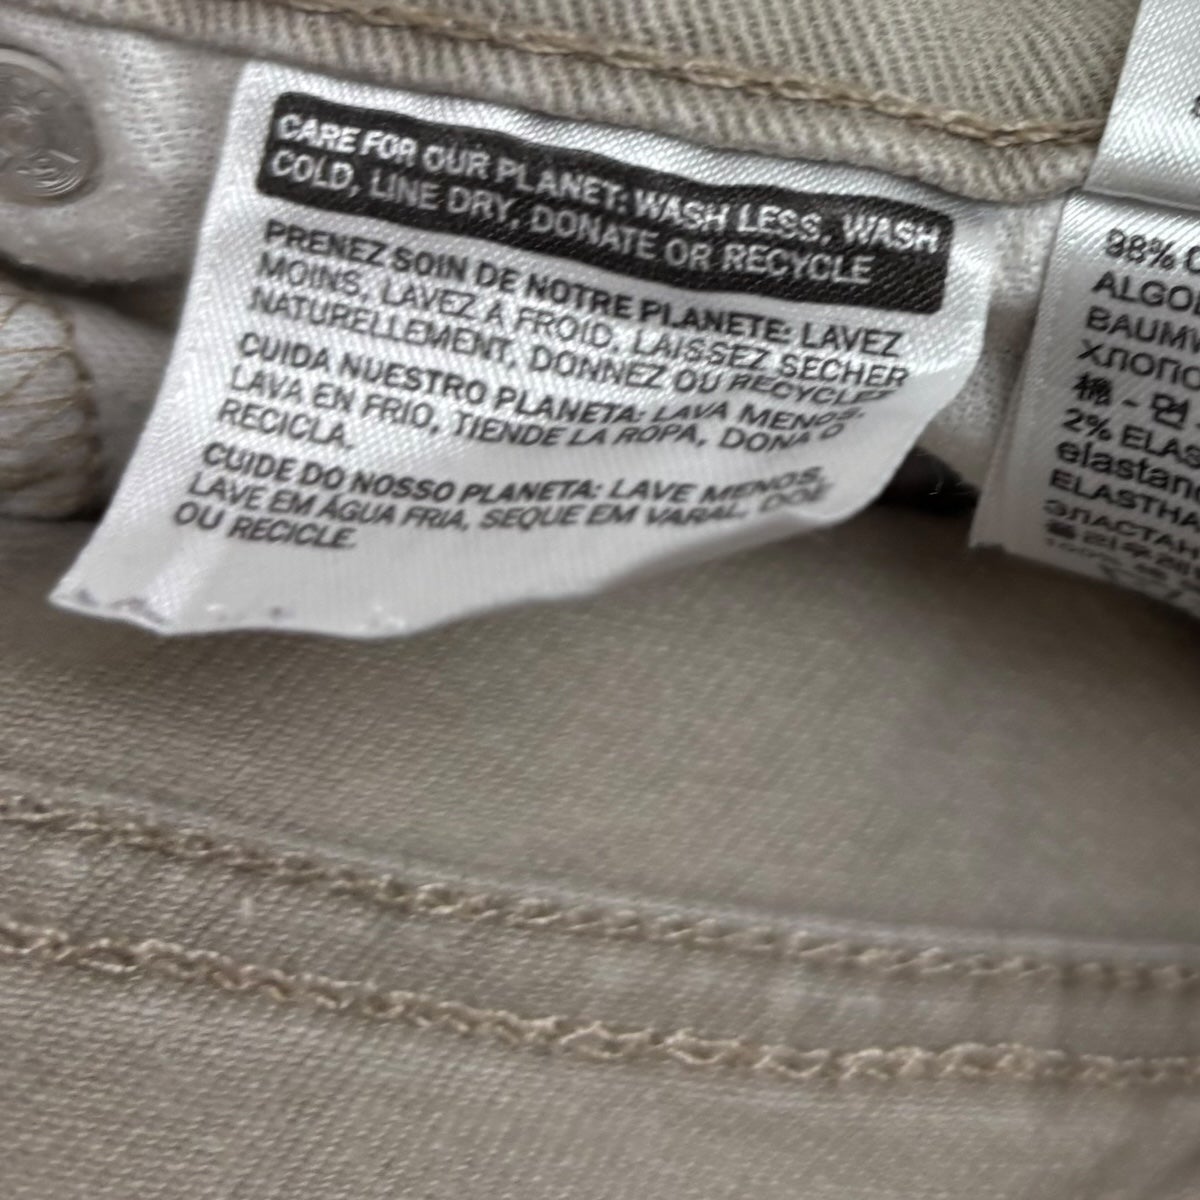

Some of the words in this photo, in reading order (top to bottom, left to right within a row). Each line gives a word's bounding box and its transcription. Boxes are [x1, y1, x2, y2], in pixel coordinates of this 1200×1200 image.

[270, 150, 362, 198] COLD,
[370, 168, 441, 211] LINE
[530, 205, 660, 260] DONATE
[664, 237, 713, 272] OR
[721, 243, 876, 285] RECYCLE
[276, 113, 361, 154] CARE
[362, 128, 418, 169] FOR
[422, 145, 491, 180] OUR
[496, 156, 627, 214] PLANET:
[635, 189, 732, 233] WASH
[841, 213, 941, 254] WASH
[264, 218, 388, 267] PRENEZ
[390, 246, 470, 282] SOIN
[475, 261, 521, 295] DE
[526, 272, 634, 321] NOTRE
[801, 321, 904, 357] LAVEZ
[1104, 227, 1177, 272] 98%
[381, 279, 478, 321] LAVEZ
[634, 328, 772, 371] LAISSEZ
[779, 353, 909, 388] SECHER
[529, 344, 667, 390] DONNEZ
[673, 367, 722, 394] OU
[229, 364, 305, 401] LAVA
[312, 381, 355, 414] EN
[451, 409, 564, 447] TIENDE
[568, 426, 614, 447] LA
[717, 421, 811, 453] DONA
[818, 421, 847, 441] O
[237, 331, 331, 372] CUIDA
[338, 351, 489, 404] NUESTRO
[494, 385, 645, 428] PLANETA:
[652, 401, 727, 423] LAVA
[1062, 406, 1114, 443] 2%
[187, 470, 262, 512] LAVE
[268, 488, 313, 516] EM
[478, 504, 583, 531] SEQUE
[585, 504, 639, 527] EM
[201, 440, 299, 484] CUIDE
[299, 460, 345, 491] DO
[351, 469, 456, 502] NOSSO
[608, 478, 697, 503] LAVE
[173, 501, 226, 531] OU
